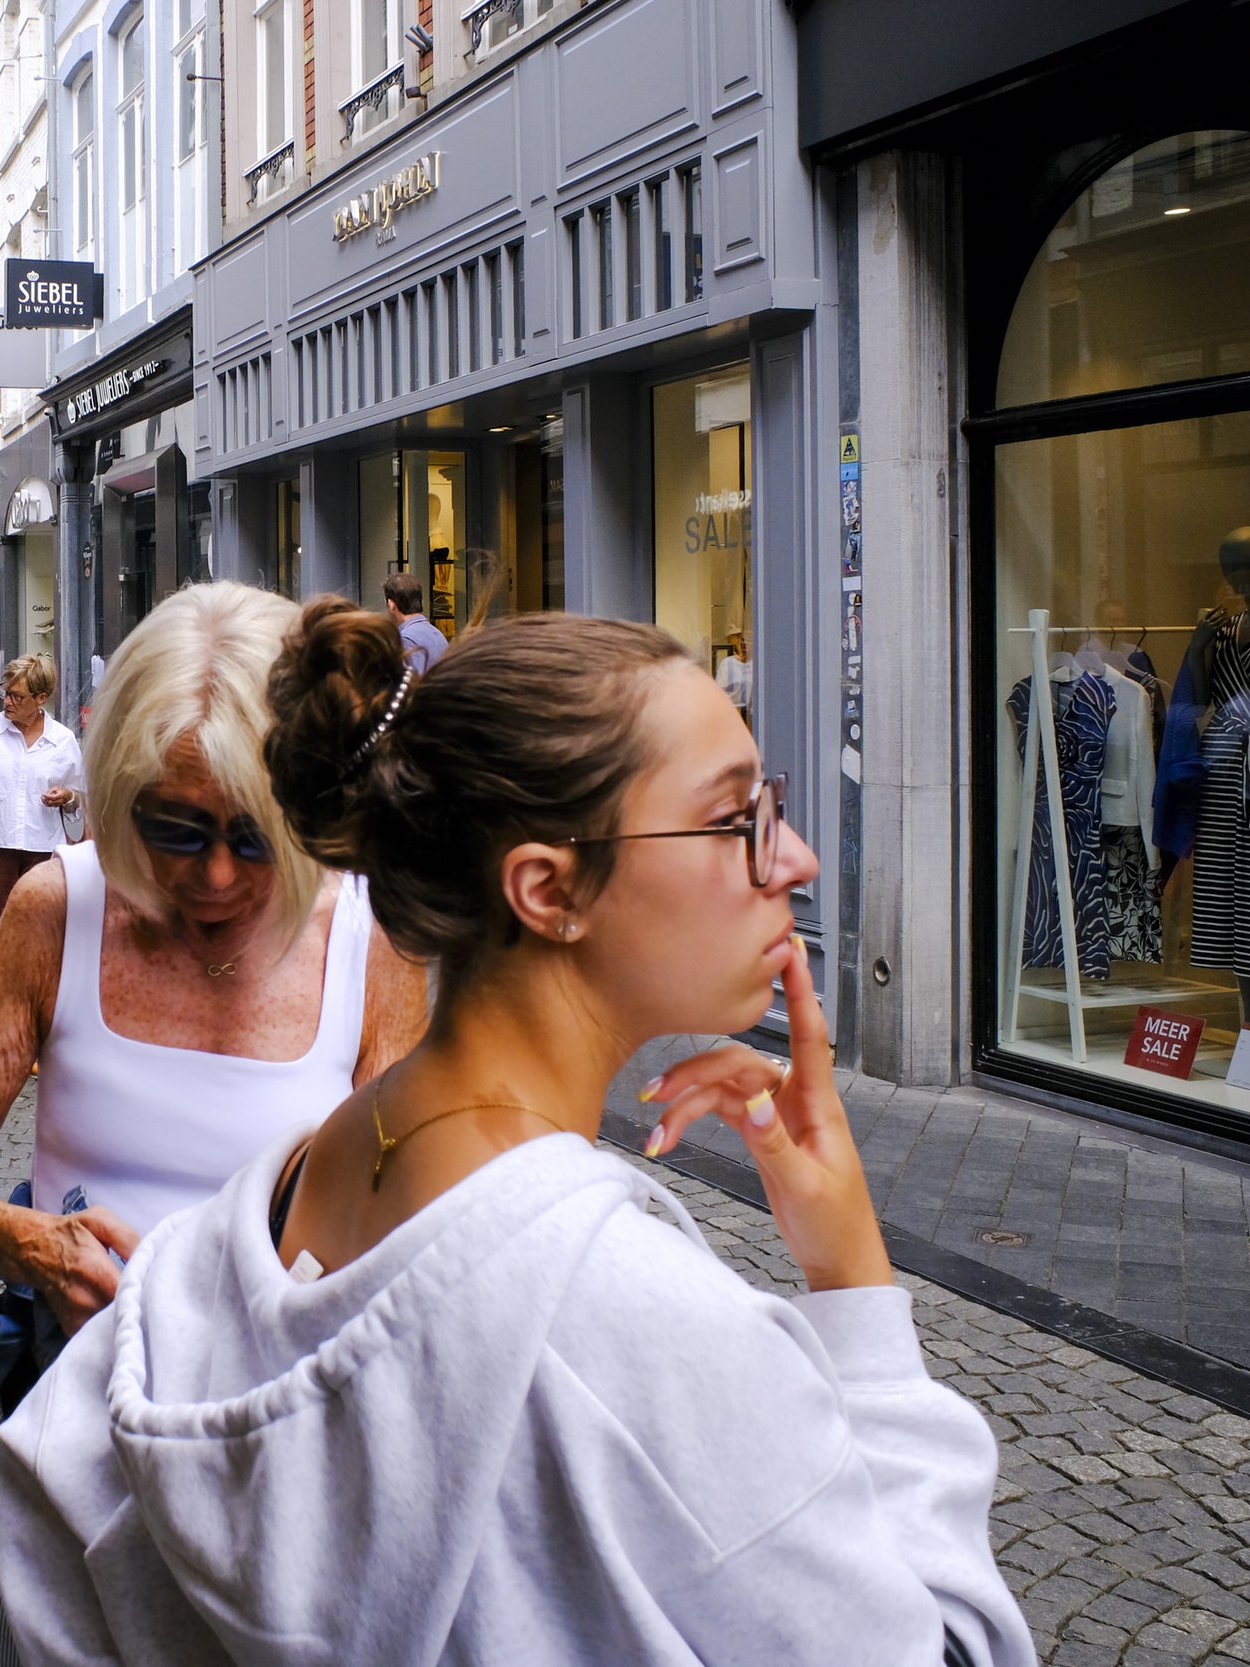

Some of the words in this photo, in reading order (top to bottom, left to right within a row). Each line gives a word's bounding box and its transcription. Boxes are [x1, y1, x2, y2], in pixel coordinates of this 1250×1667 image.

[17, 281, 84, 305] SIEBEL
[18, 304, 84, 315] Juweliers
[75, 388, 97, 418] SIEBEL
[95, 369, 130, 413] JUWELIERS
[685, 509, 752, 555] SALE
[32, 604, 51, 612] Gabor
[1144, 1016, 1190, 1042] MEER
[1141, 1037, 1182, 1061] SALE
